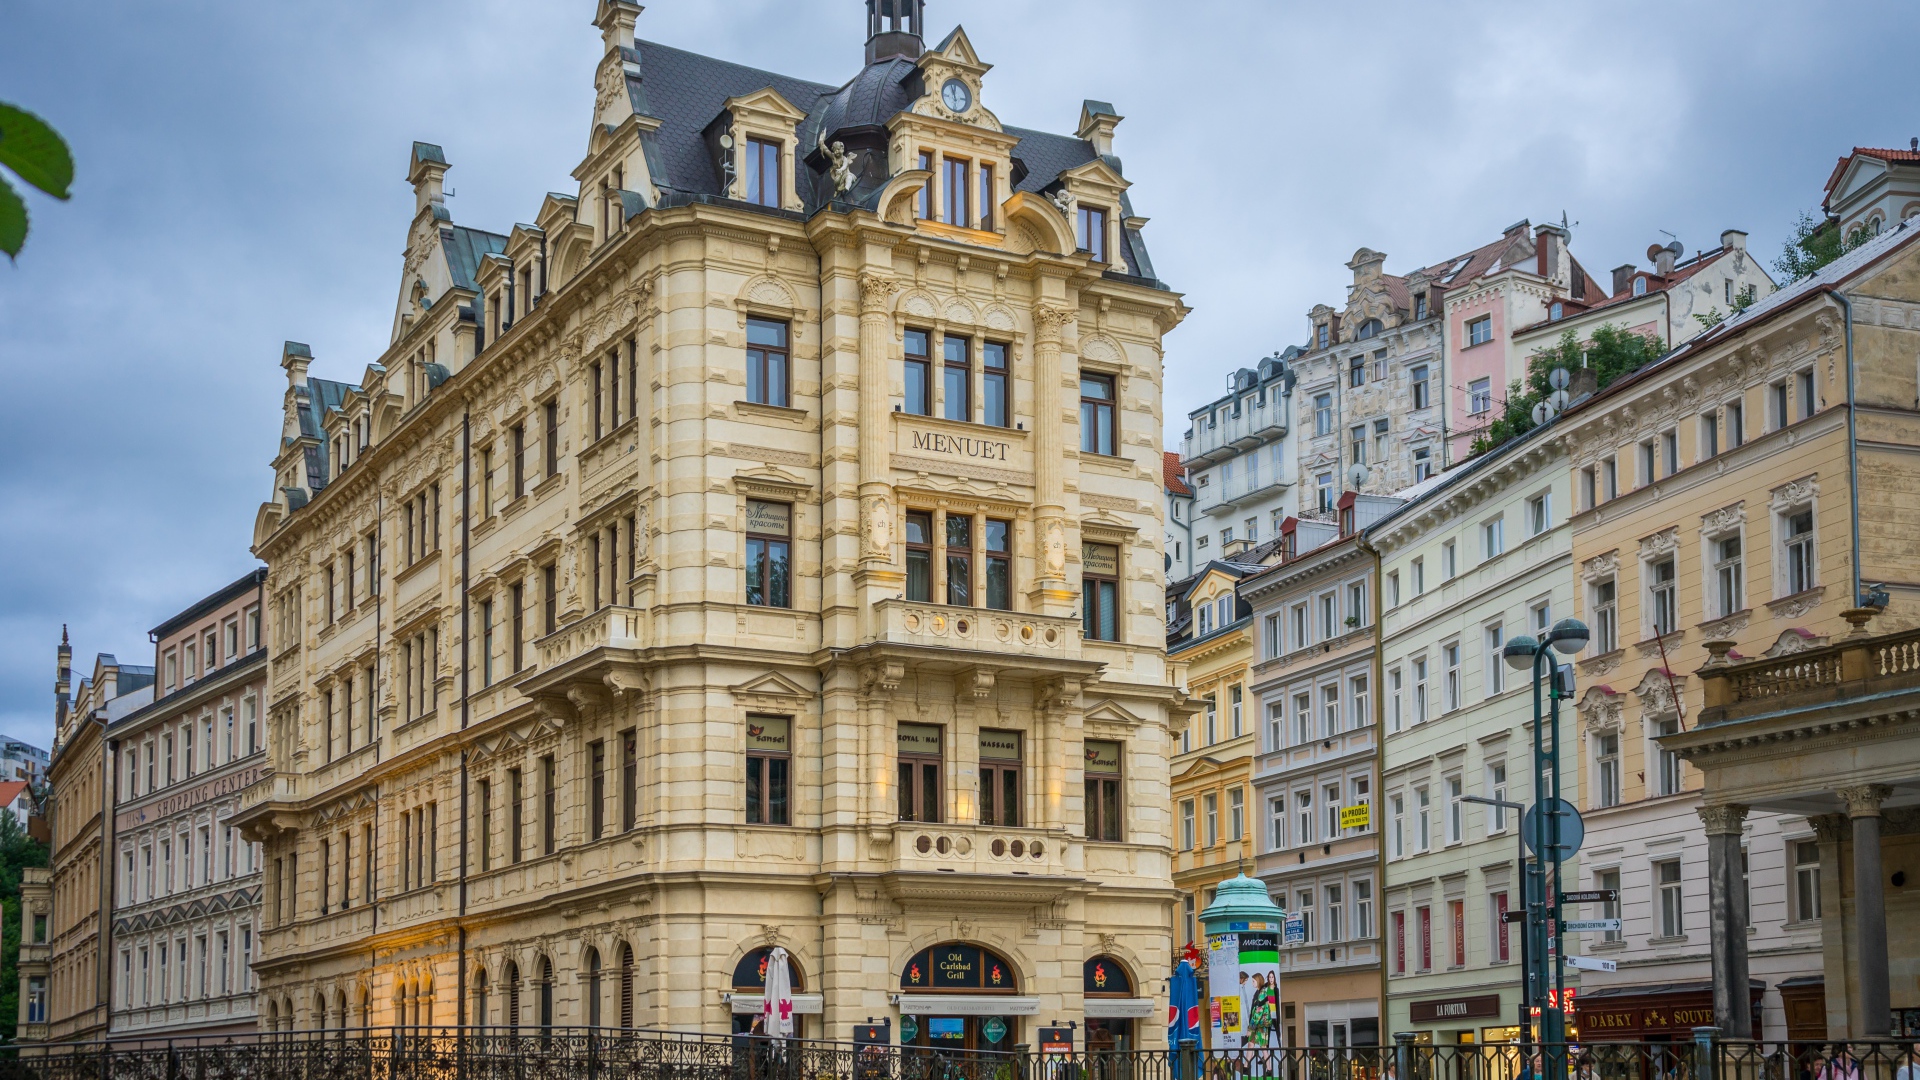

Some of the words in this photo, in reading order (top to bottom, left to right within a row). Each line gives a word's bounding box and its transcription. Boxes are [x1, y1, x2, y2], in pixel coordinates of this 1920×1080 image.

[912, 430, 1010, 461] MENUET
[749, 519, 785, 530] красоты
[756, 735, 785, 744] sansei
[980, 740, 1015, 750] MASSAGE
[157, 786, 208, 818] SHOPPING
[213, 768, 258, 797] CENTER
[1348, 806, 1368, 818] PRODEJ
[1588, 921, 1607, 929] CENTRUM
[947, 953, 962, 962] Old
[1568, 957, 1577, 966] WC
[940, 962, 971, 971] Carlsbad
[946, 971, 965, 980] Grill
[1436, 1004, 1444, 1017] LA
[1444, 1002, 1467, 1016] FORTUNA
[1589, 1011, 1632, 1028] DÁRKY
[1673, 1008, 1714, 1025] SOUVE
